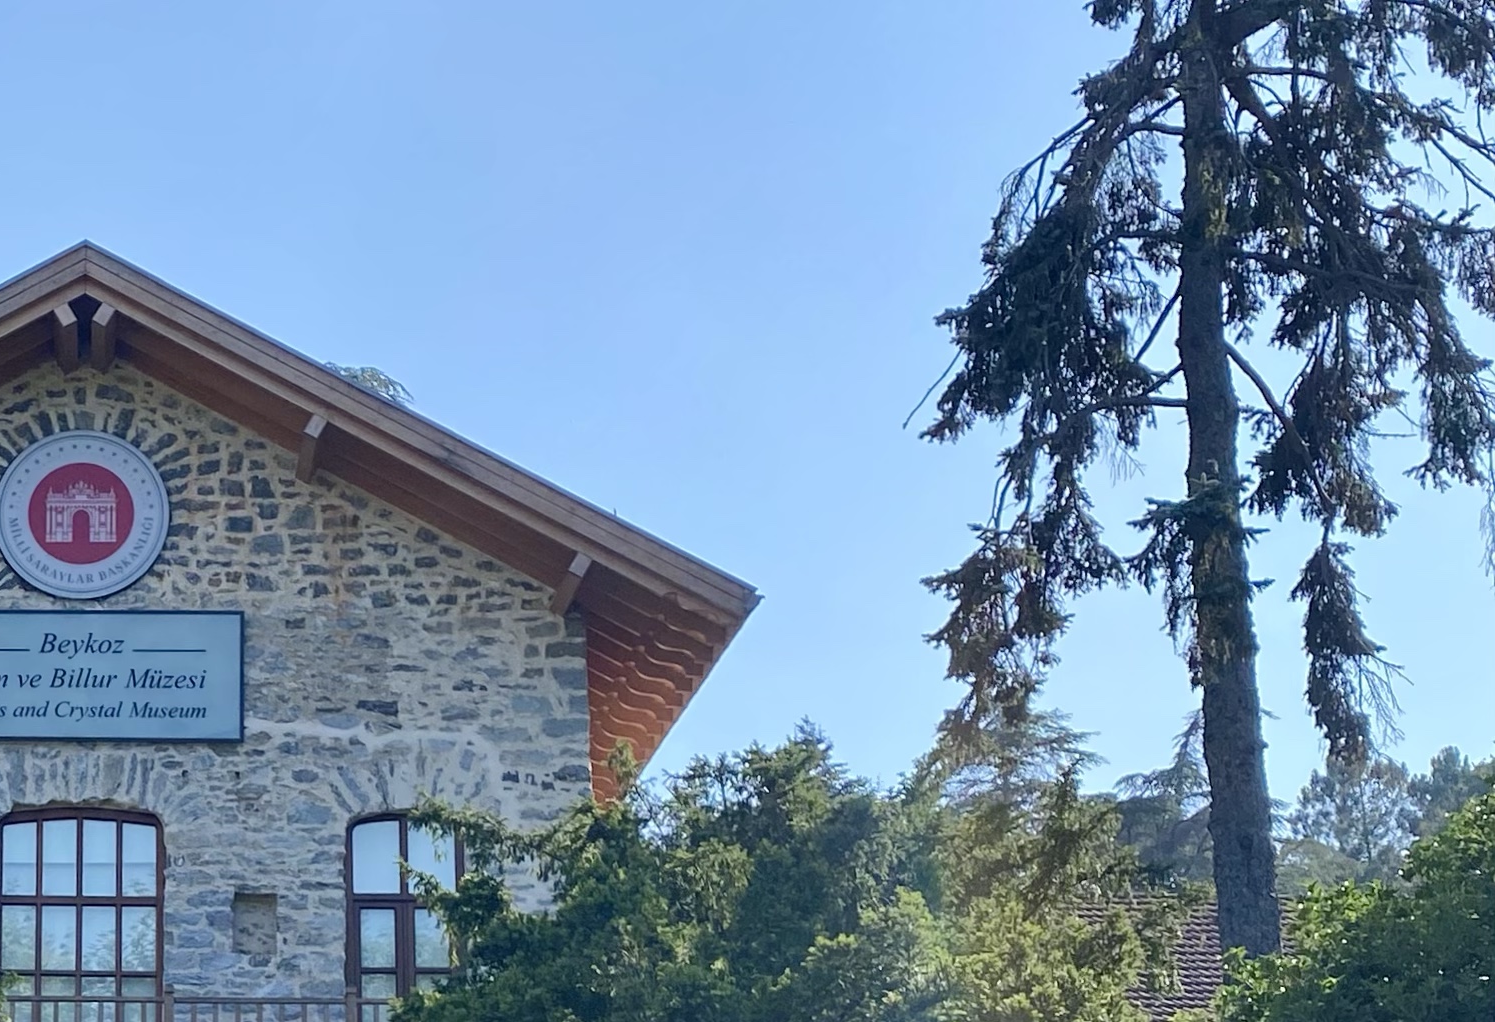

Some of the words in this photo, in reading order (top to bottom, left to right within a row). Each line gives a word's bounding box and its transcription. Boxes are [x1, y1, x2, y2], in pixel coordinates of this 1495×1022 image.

[8, 516, 28, 555] MİLLİ
[25, 552, 95, 584] SARAYLAR
[98, 516, 155, 582] BAŞKANLIĞI
[38, 632, 125, 660] Beykoz
[17, 673, 42, 688] ve
[49, 667, 118, 689] Billur
[124, 668, 207, 690] Müzesi
[12, 700, 49, 718] and
[54, 700, 123, 722] Crystal
[129, 701, 207, 719] Museum
